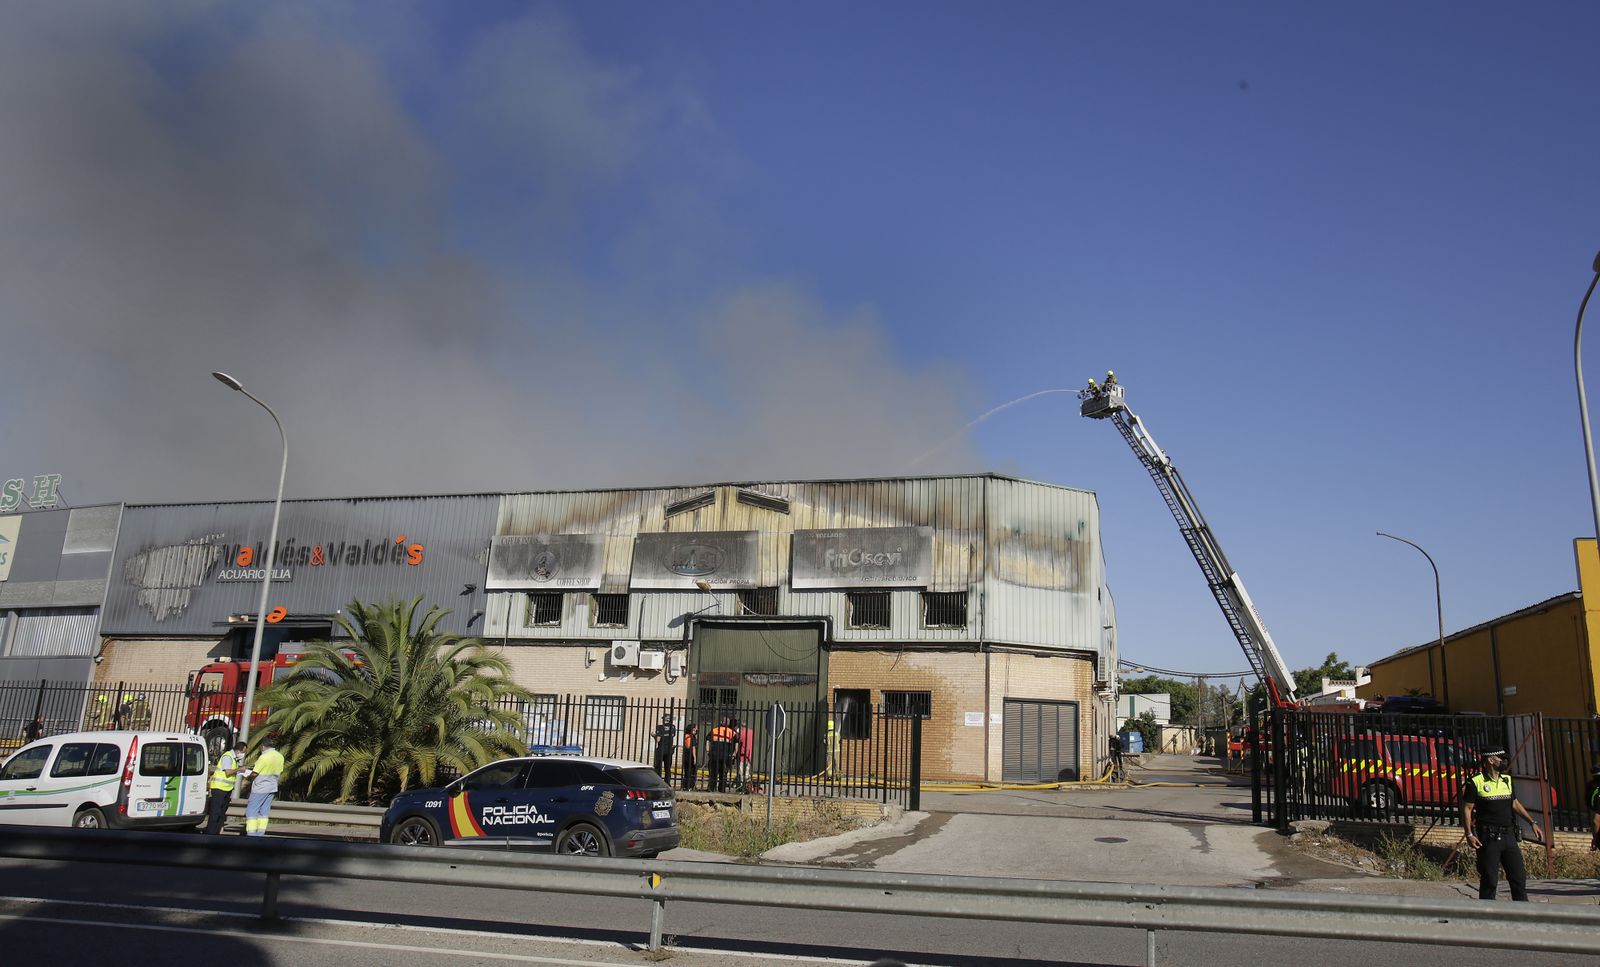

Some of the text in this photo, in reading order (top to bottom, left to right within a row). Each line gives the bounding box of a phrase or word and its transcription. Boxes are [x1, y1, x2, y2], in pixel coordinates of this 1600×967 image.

[217, 569, 291, 579] ACUARIOILIA
[482, 804, 538, 816] POLICÍA
[482, 814, 555, 826] NACIONAL
